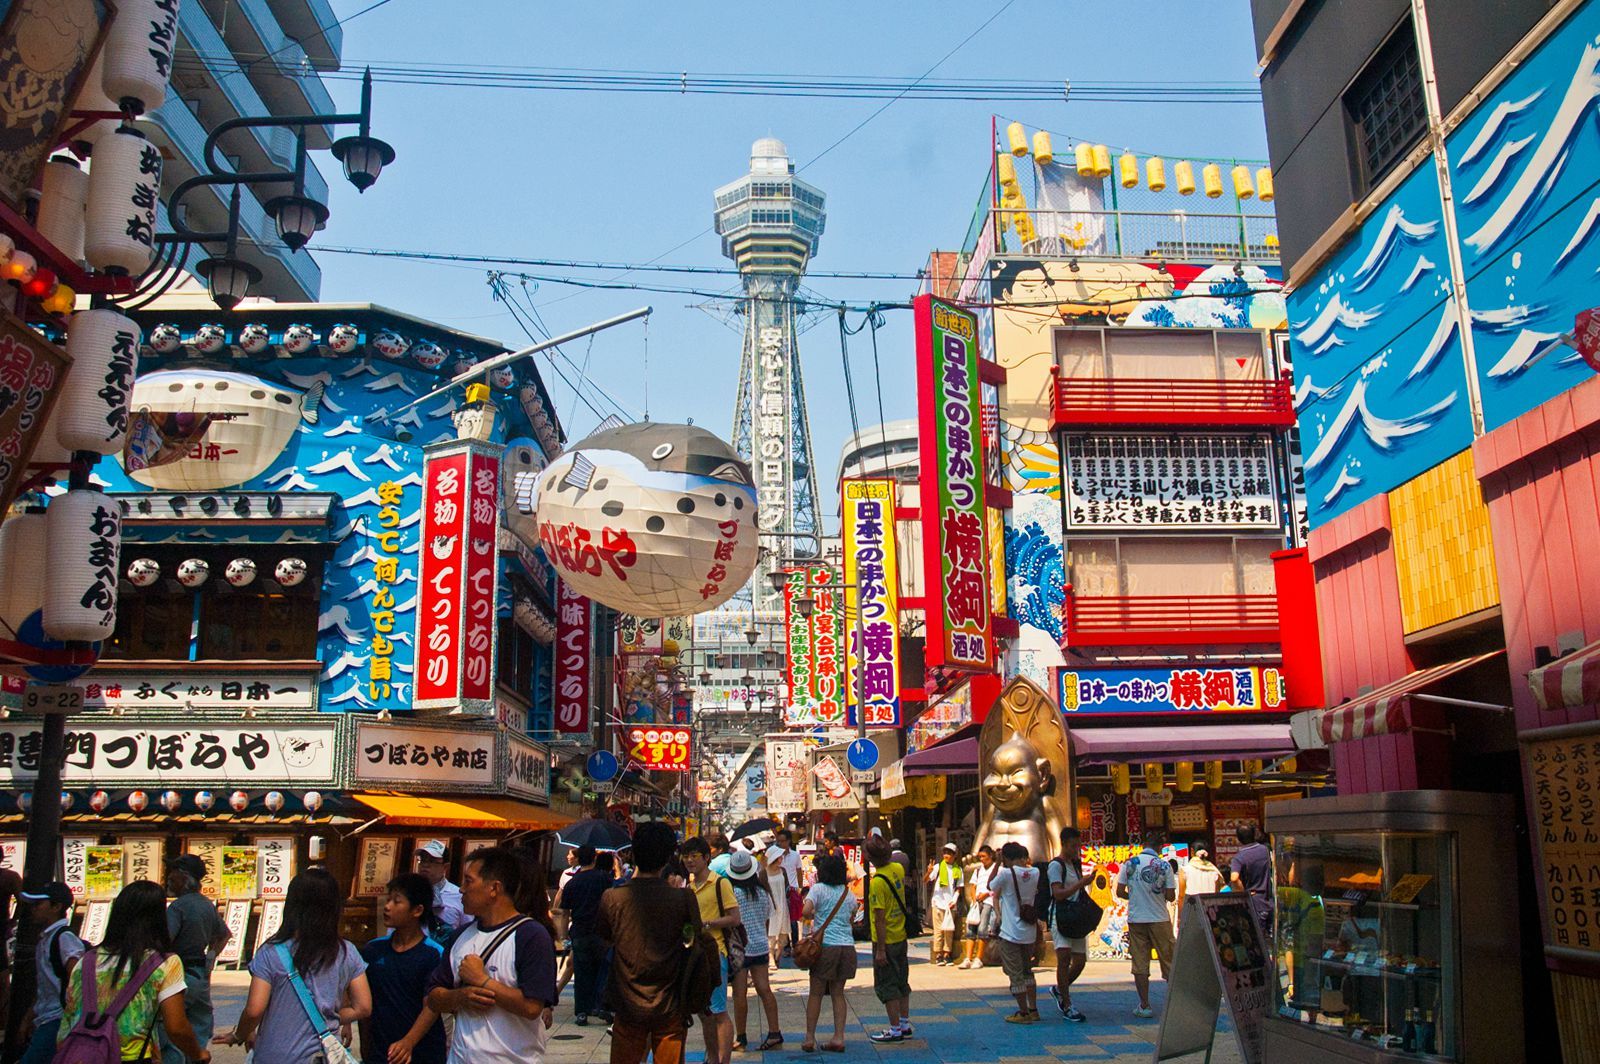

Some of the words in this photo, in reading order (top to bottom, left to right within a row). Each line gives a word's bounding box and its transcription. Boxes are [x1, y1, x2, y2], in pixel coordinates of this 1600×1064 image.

[934, 305, 974, 340] 新世界
[434, 467, 459, 526] 名物
[474, 468, 496, 526] 名物
[847, 483, 891, 499] 新世界
[1114, 478, 1128, 523] にんにく
[1129, 478, 1144, 523] 玉ねぎ
[1172, 478, 1188, 523] れんこん
[699, 519, 740, 600] づぼらや
[427, 567, 454, 687] てっちり
[467, 567, 492, 687] てっちり
[731, 688, 774, 700] ゆるキラ
[1080, 680, 1168, 702] 日本一の串かつ
[1170, 671, 1234, 707] 横綱
[1236, 671, 1254, 706] 酒処
[364, 742, 488, 770] づぼらや本店
[630, 741, 687, 763] くすり
